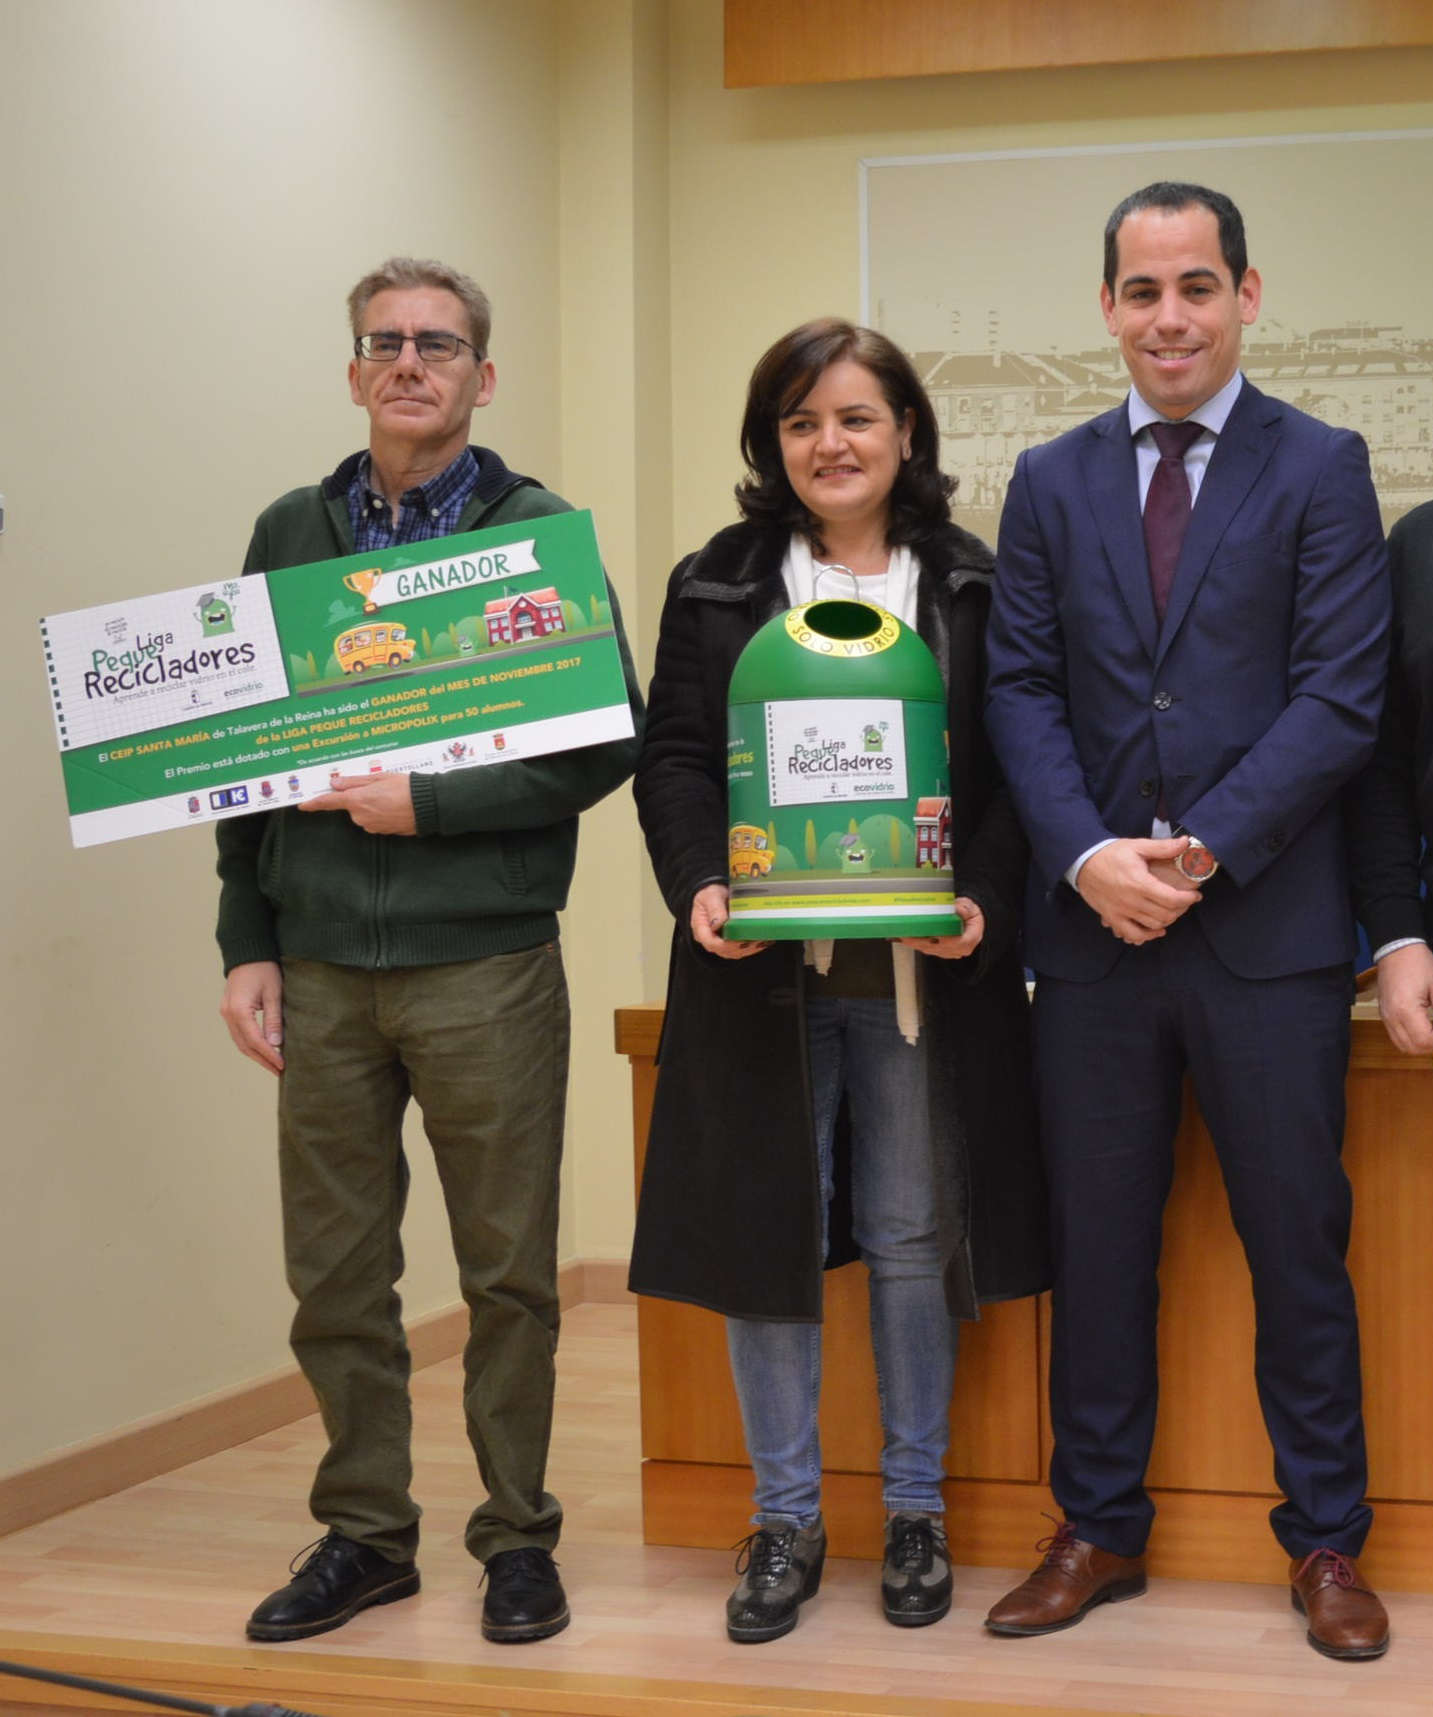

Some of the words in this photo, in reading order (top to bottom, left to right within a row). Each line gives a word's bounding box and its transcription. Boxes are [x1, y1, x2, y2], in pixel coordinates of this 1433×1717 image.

[396, 552, 512, 599] GANADOR
[135, 629, 175, 656] Liga
[844, 627, 895, 655] VIDRIO
[84, 640, 257, 700] Recicladores
[93, 644, 158, 682] Peque
[98, 752, 108, 762] El
[109, 747, 134, 760] CEIP
[136, 739, 172, 754] SANTA
[174, 729, 210, 747] MARÍA
[211, 728, 225, 739] de
[226, 719, 267, 736] Talavera
[268, 716, 282, 728] de
[283, 714, 293, 725] la
[294, 708, 322, 722] Reina
[323, 706, 336, 717] ha
[337, 701, 358, 714] sido
[359, 698, 370, 709] el
[371, 687, 426, 707] GANADOR
[428, 683, 445, 695] del
[446, 678, 470, 692] MES
[471, 675, 487, 687] DE
[489, 662, 554, 683] NOVIEMBRE
[555, 656, 582, 670] 2017
[255, 733, 268, 745] de
[270, 731, 280, 742] la
[282, 726, 307, 739] LIGA
[309, 718, 346, 734] PEQUE
[348, 701, 429, 726] RECICLADORES
[164, 767, 174, 778] El
[176, 760, 211, 776] Premio
[212, 756, 233, 768] está
[234, 748, 270, 764] dotado
[271, 745, 290, 756] con
[291, 742, 310, 752] una
[311, 730, 360, 748] Excursión
[370, 714, 438, 736] MICROPOLIX
[440, 711, 464, 724] para
[465, 706, 479, 717] 50
[480, 697, 525, 714] alumnos.
[794, 743, 833, 762] Peque
[821, 738, 846, 753] Liga
[787, 751, 893, 774] Recicladores
